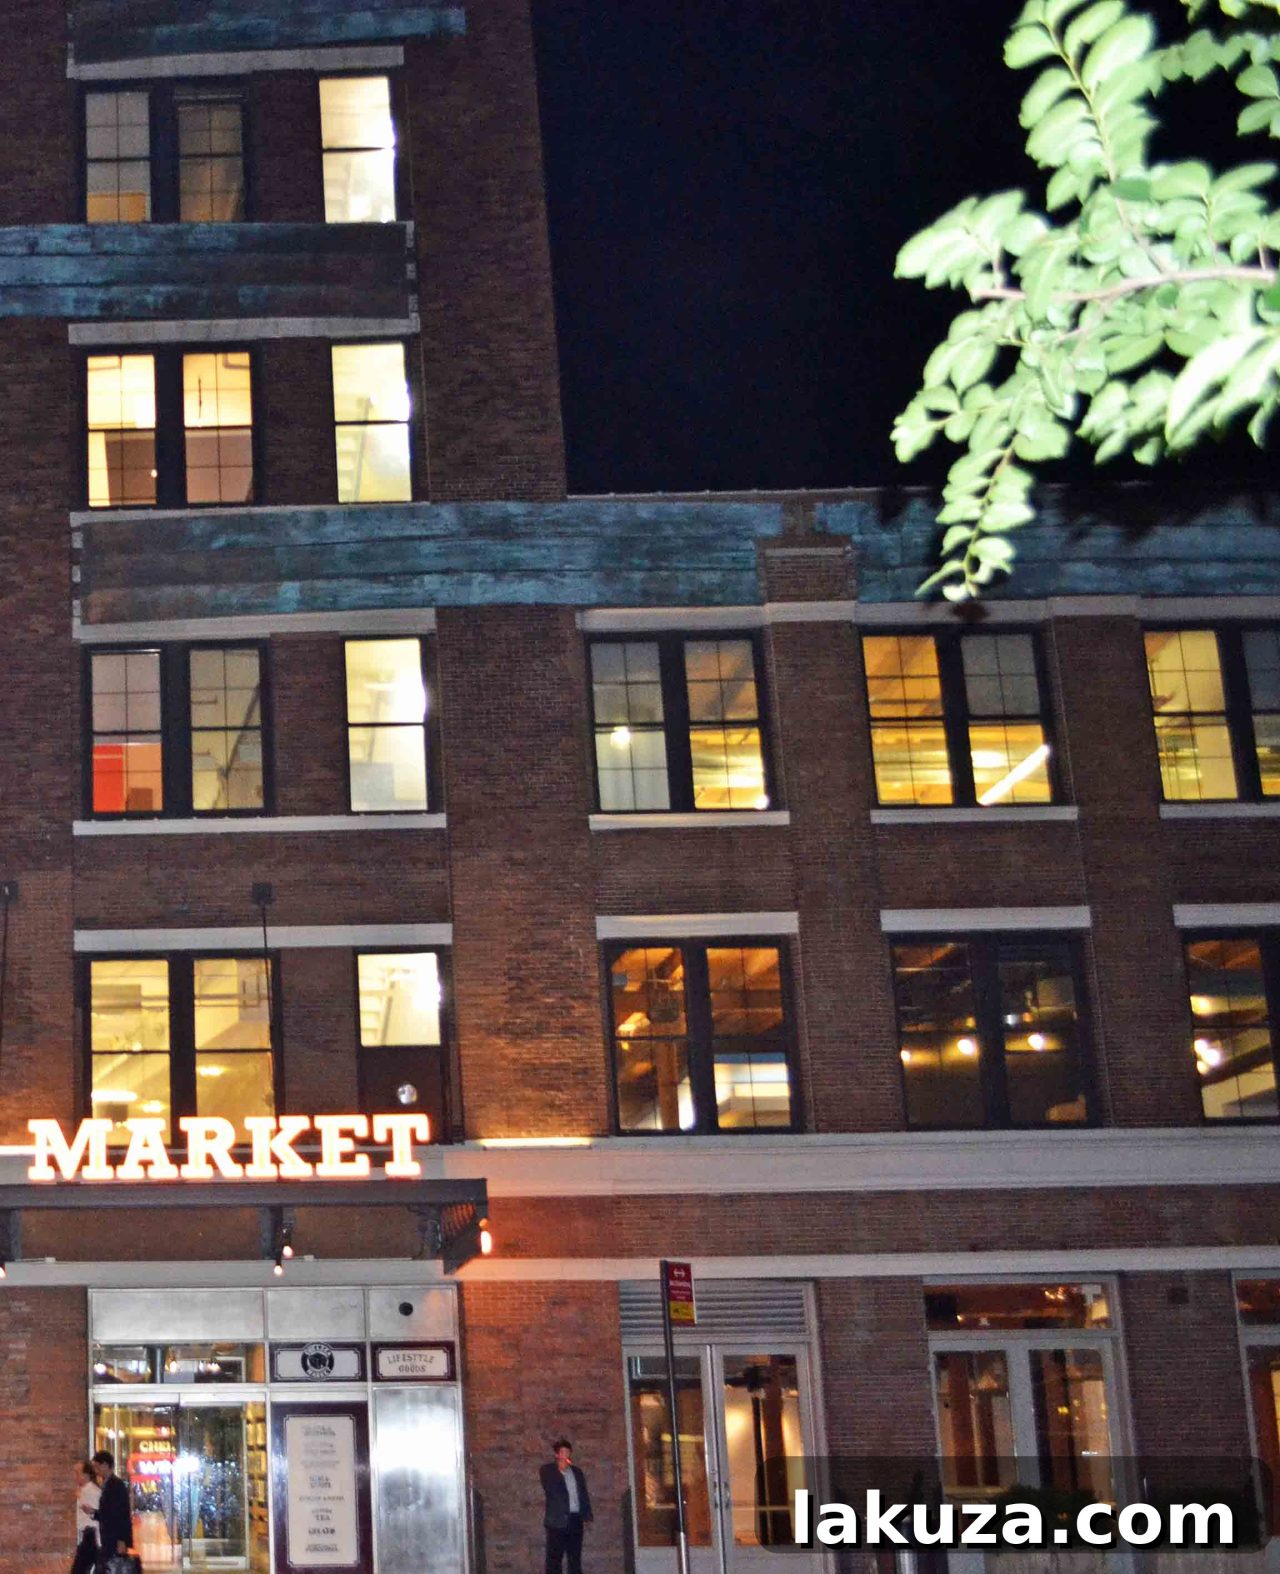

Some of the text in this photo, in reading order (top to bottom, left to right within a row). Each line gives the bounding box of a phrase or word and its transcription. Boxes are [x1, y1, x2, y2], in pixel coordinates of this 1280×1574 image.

[27, 1113, 431, 1181] MARKET
[386, 1353, 435, 1364] LIFESTYLE
[398, 1364, 427, 1373] GOODS
